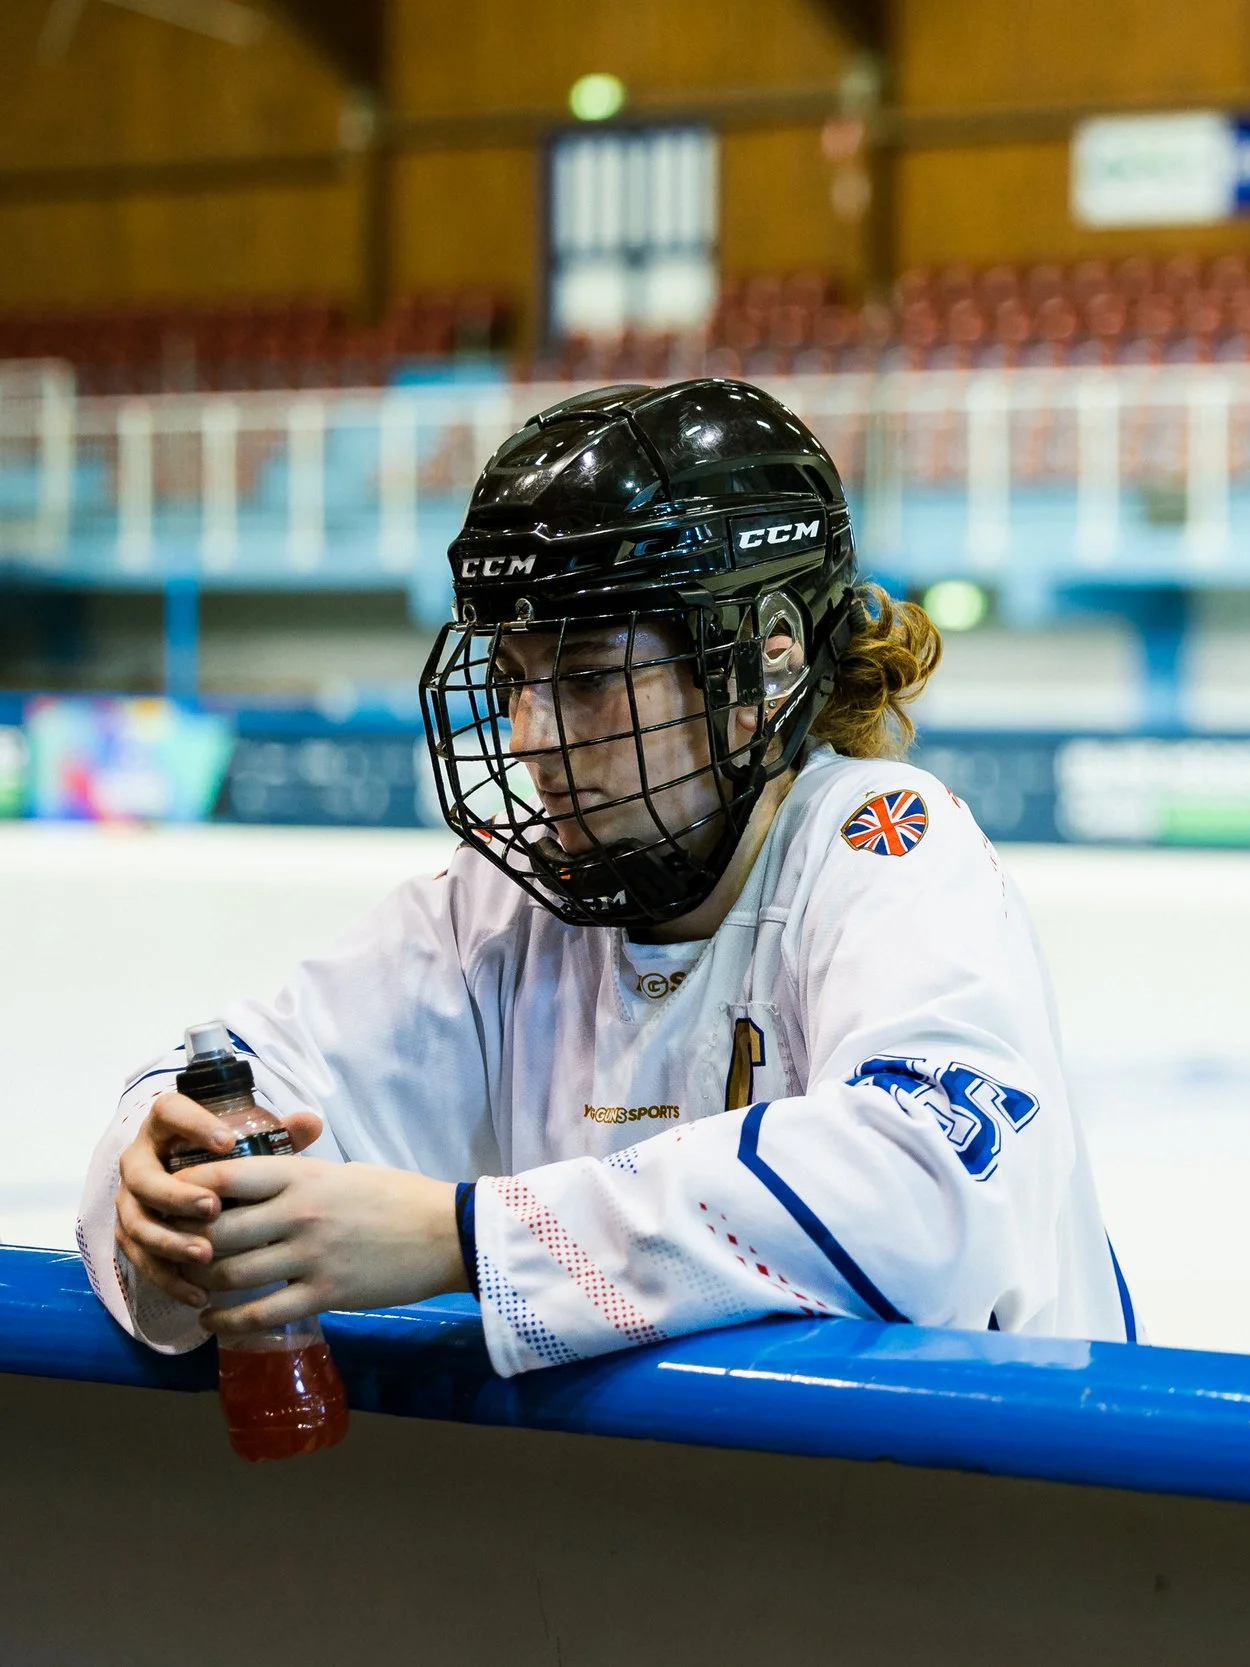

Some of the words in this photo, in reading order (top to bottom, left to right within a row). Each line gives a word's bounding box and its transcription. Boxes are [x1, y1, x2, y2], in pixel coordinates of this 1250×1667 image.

[739, 520, 820, 549] CCM
[461, 554, 537, 578] CCM
[628, 1105, 680, 1121] SPORTS
